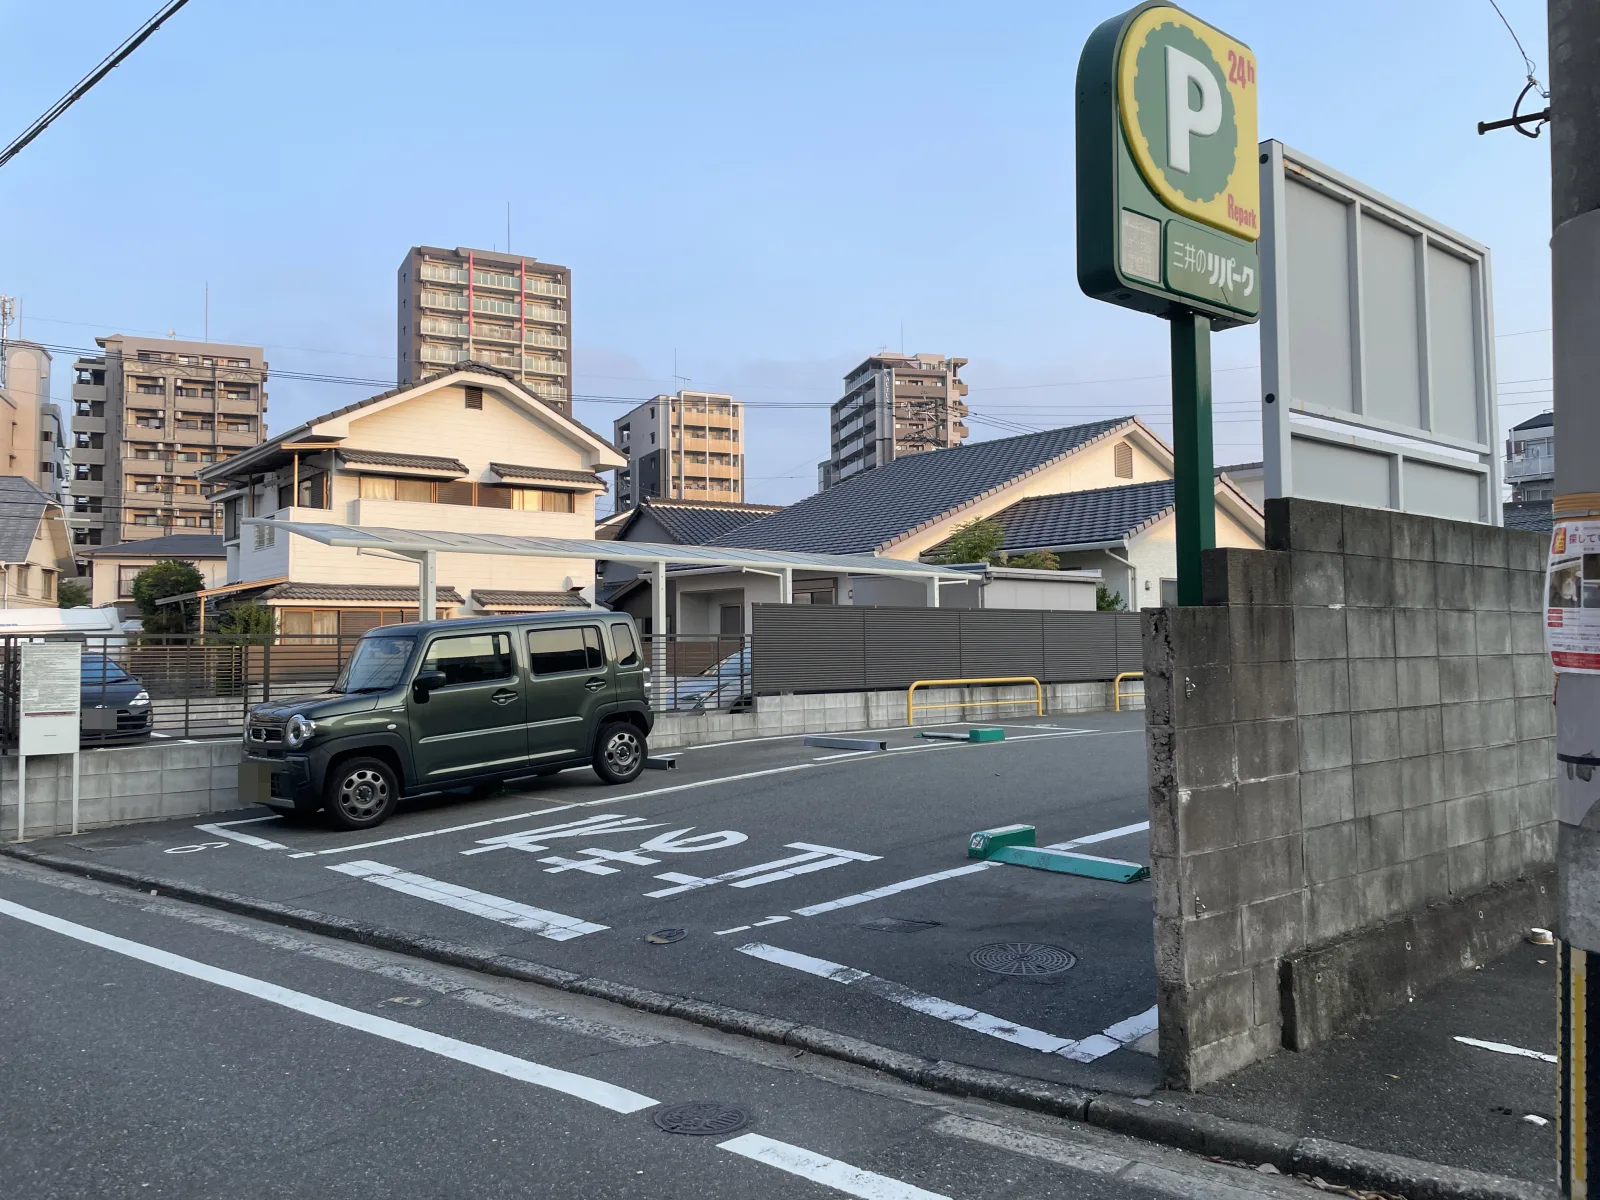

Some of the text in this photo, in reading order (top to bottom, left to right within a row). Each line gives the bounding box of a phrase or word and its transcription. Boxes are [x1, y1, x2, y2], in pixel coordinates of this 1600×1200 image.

[1227, 49, 1255, 89] 24h
[1164, 44, 1223, 176] P
[1227, 192, 1257, 230] Repark
[1173, 240, 1254, 297] 三井のリパーク
[1568, 533, 1600, 545] 探して
[459, 813, 884, 898] 止まれ
